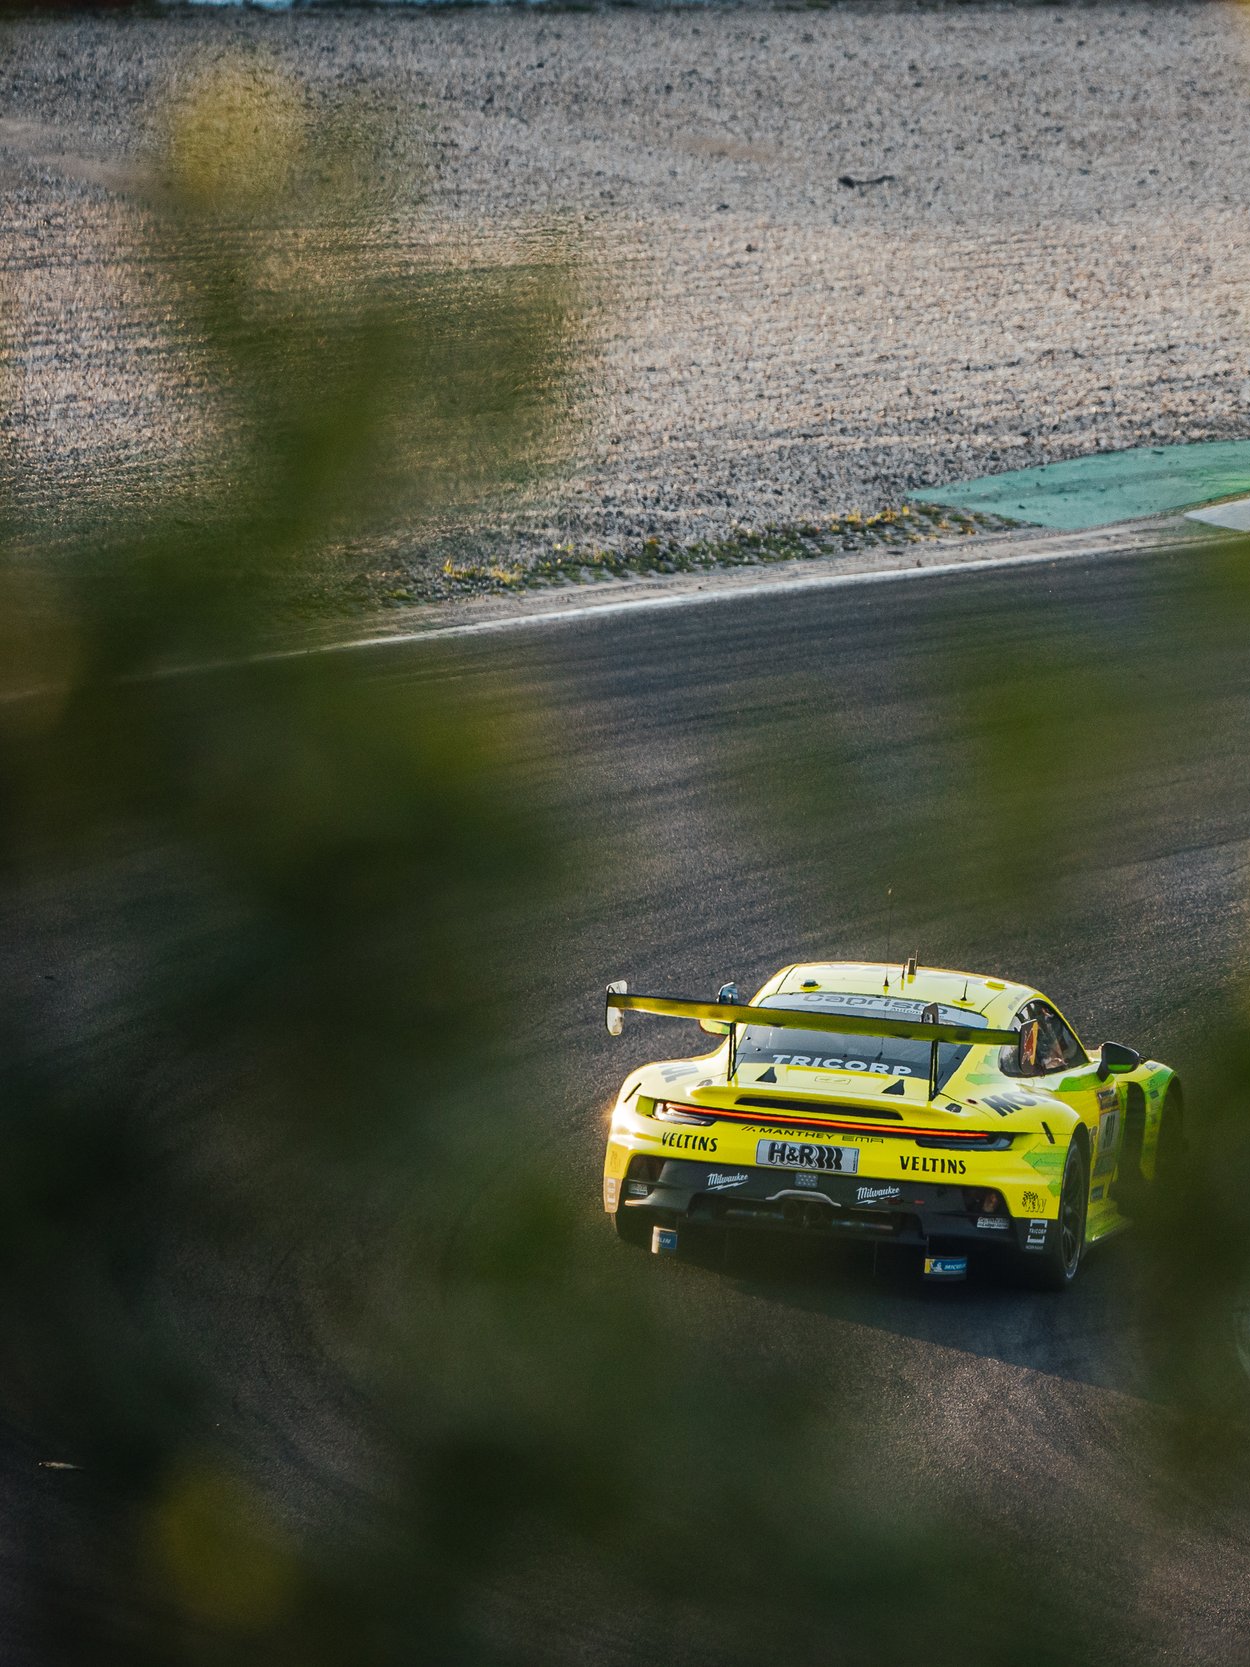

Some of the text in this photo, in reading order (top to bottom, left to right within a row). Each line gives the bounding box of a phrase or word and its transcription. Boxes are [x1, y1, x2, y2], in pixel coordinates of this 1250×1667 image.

[772, 1054, 912, 1076] TRICORP
[661, 1132, 719, 1152] VELTINS
[759, 1127, 834, 1140] MANTHEY
[767, 1142, 817, 1168] H&R
[900, 1155, 967, 1175] VELTINS
[706, 1172, 749, 1187] Milwaukee
[855, 1185, 900, 1201] Milwaukee
